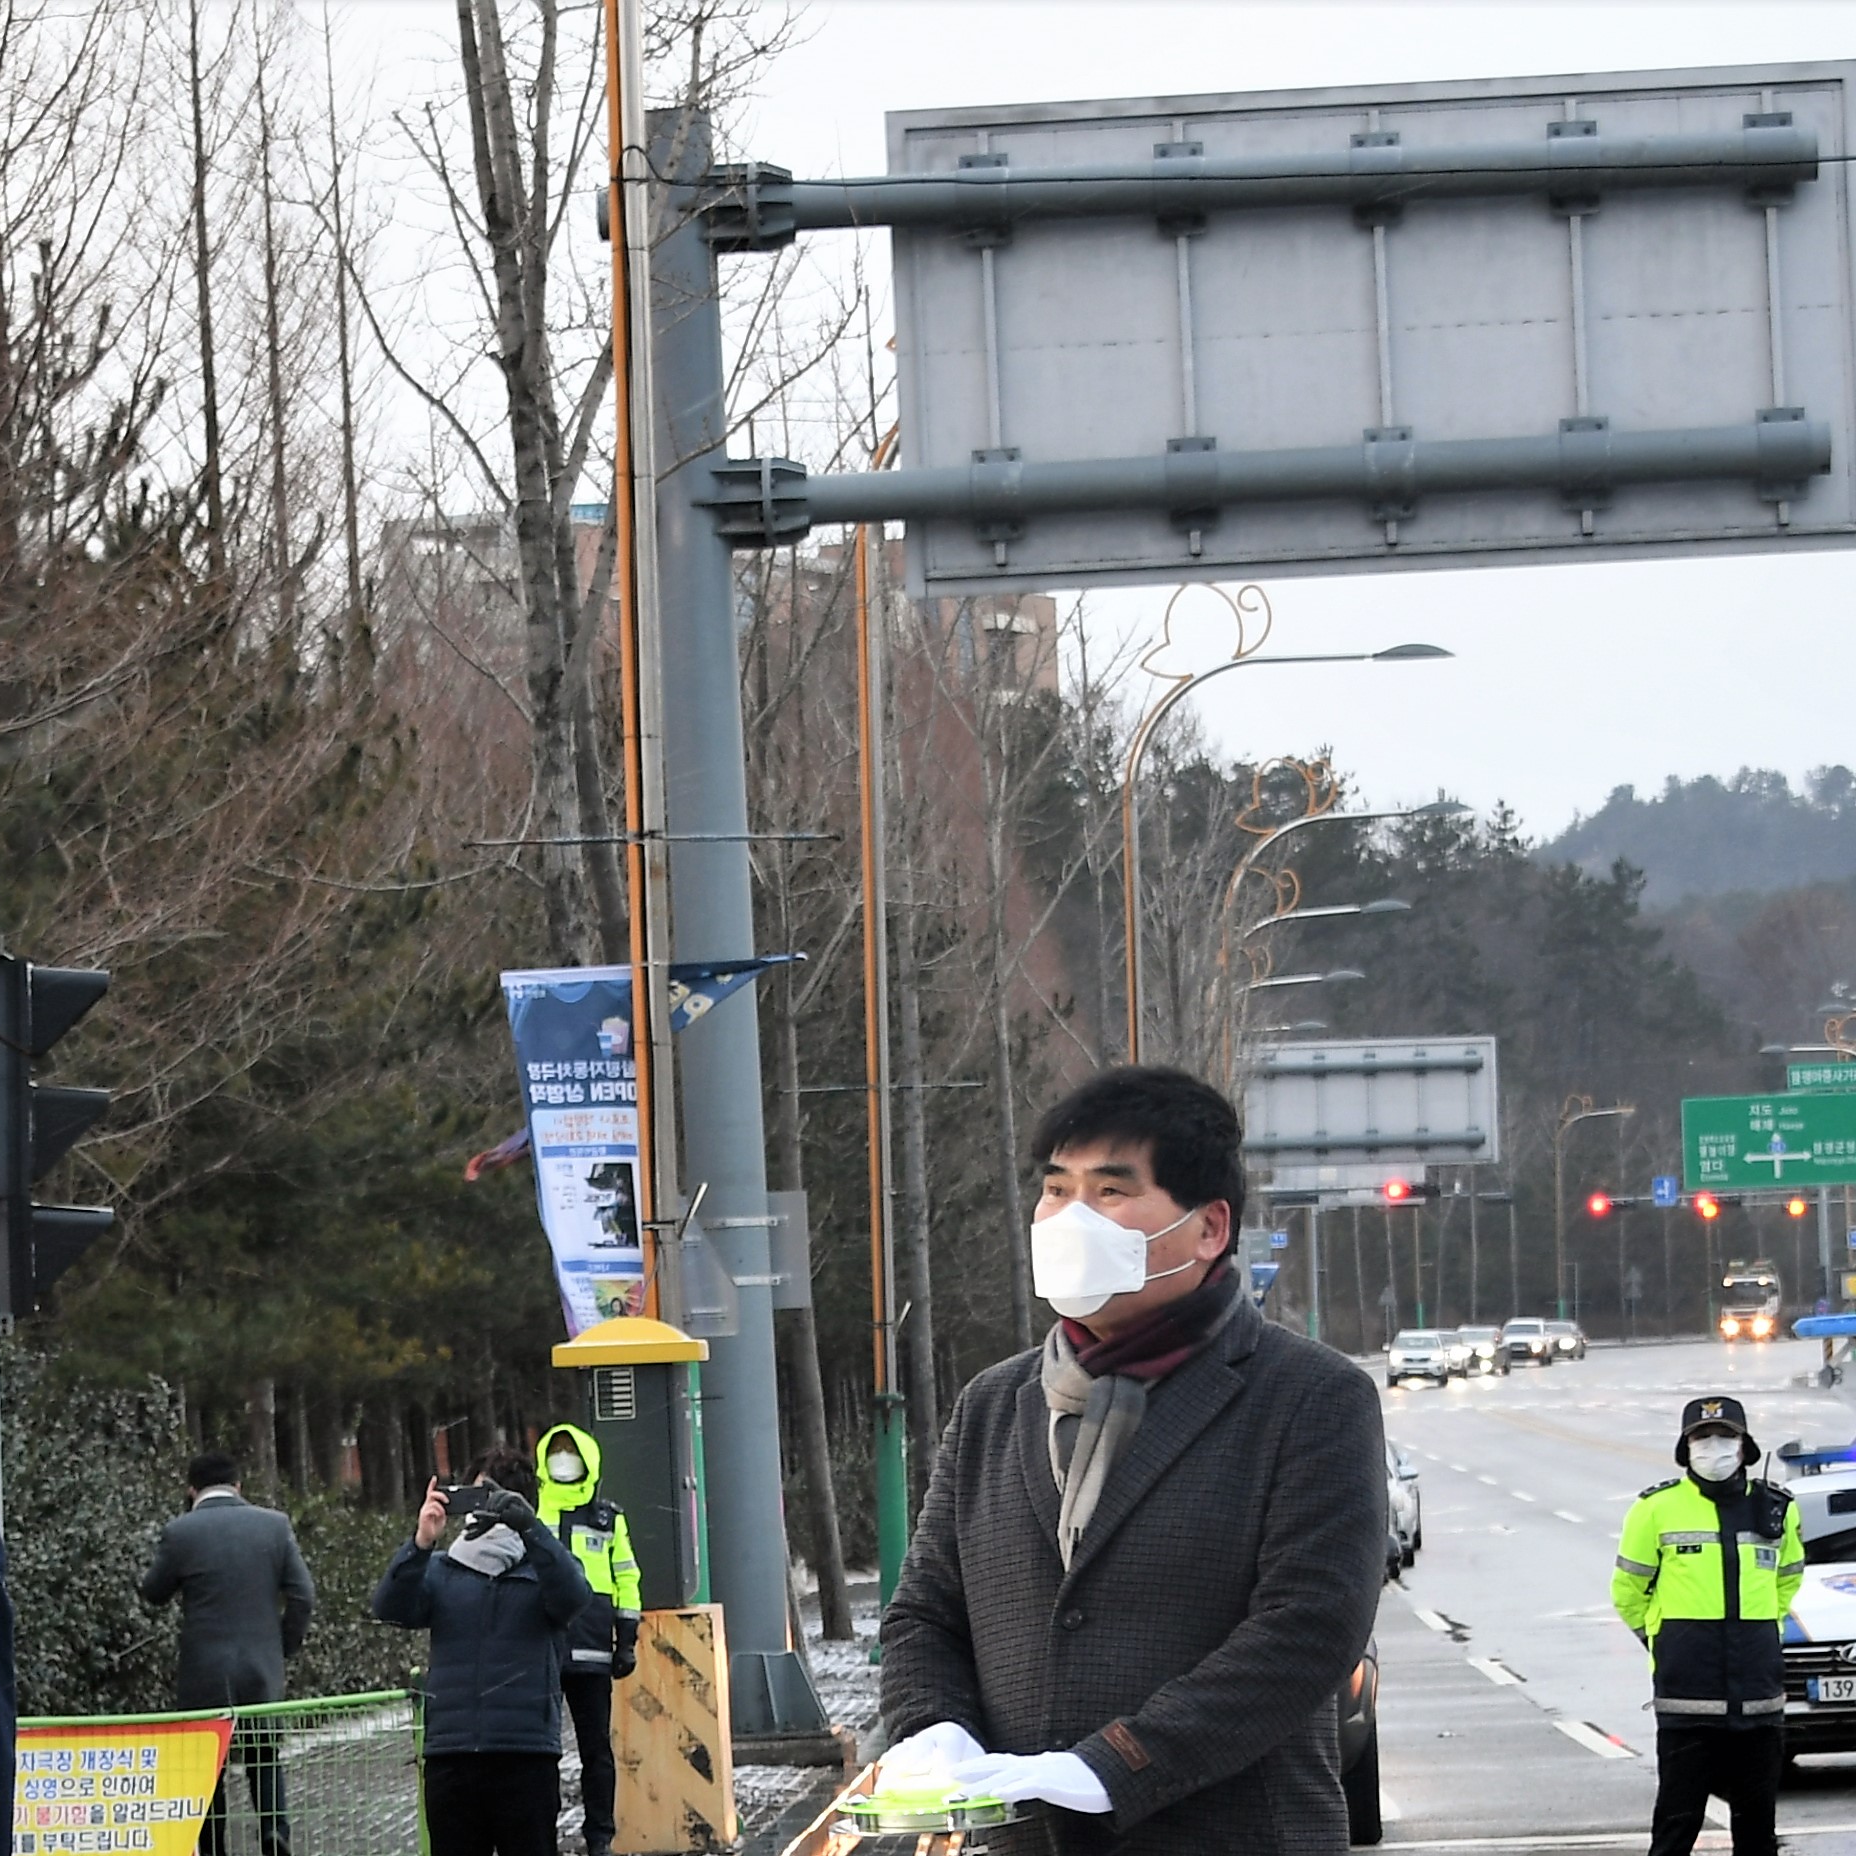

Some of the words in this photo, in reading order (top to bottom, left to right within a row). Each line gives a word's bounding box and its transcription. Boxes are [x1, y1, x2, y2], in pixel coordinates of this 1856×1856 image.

[80, 1748, 134, 1770] 개장식
[141, 1748, 157, 1769] 및
[25, 1777, 95, 1799] 상영으로
[102, 1775, 155, 1797] 인하여
[112, 1797, 204, 1823] 알려드리니
